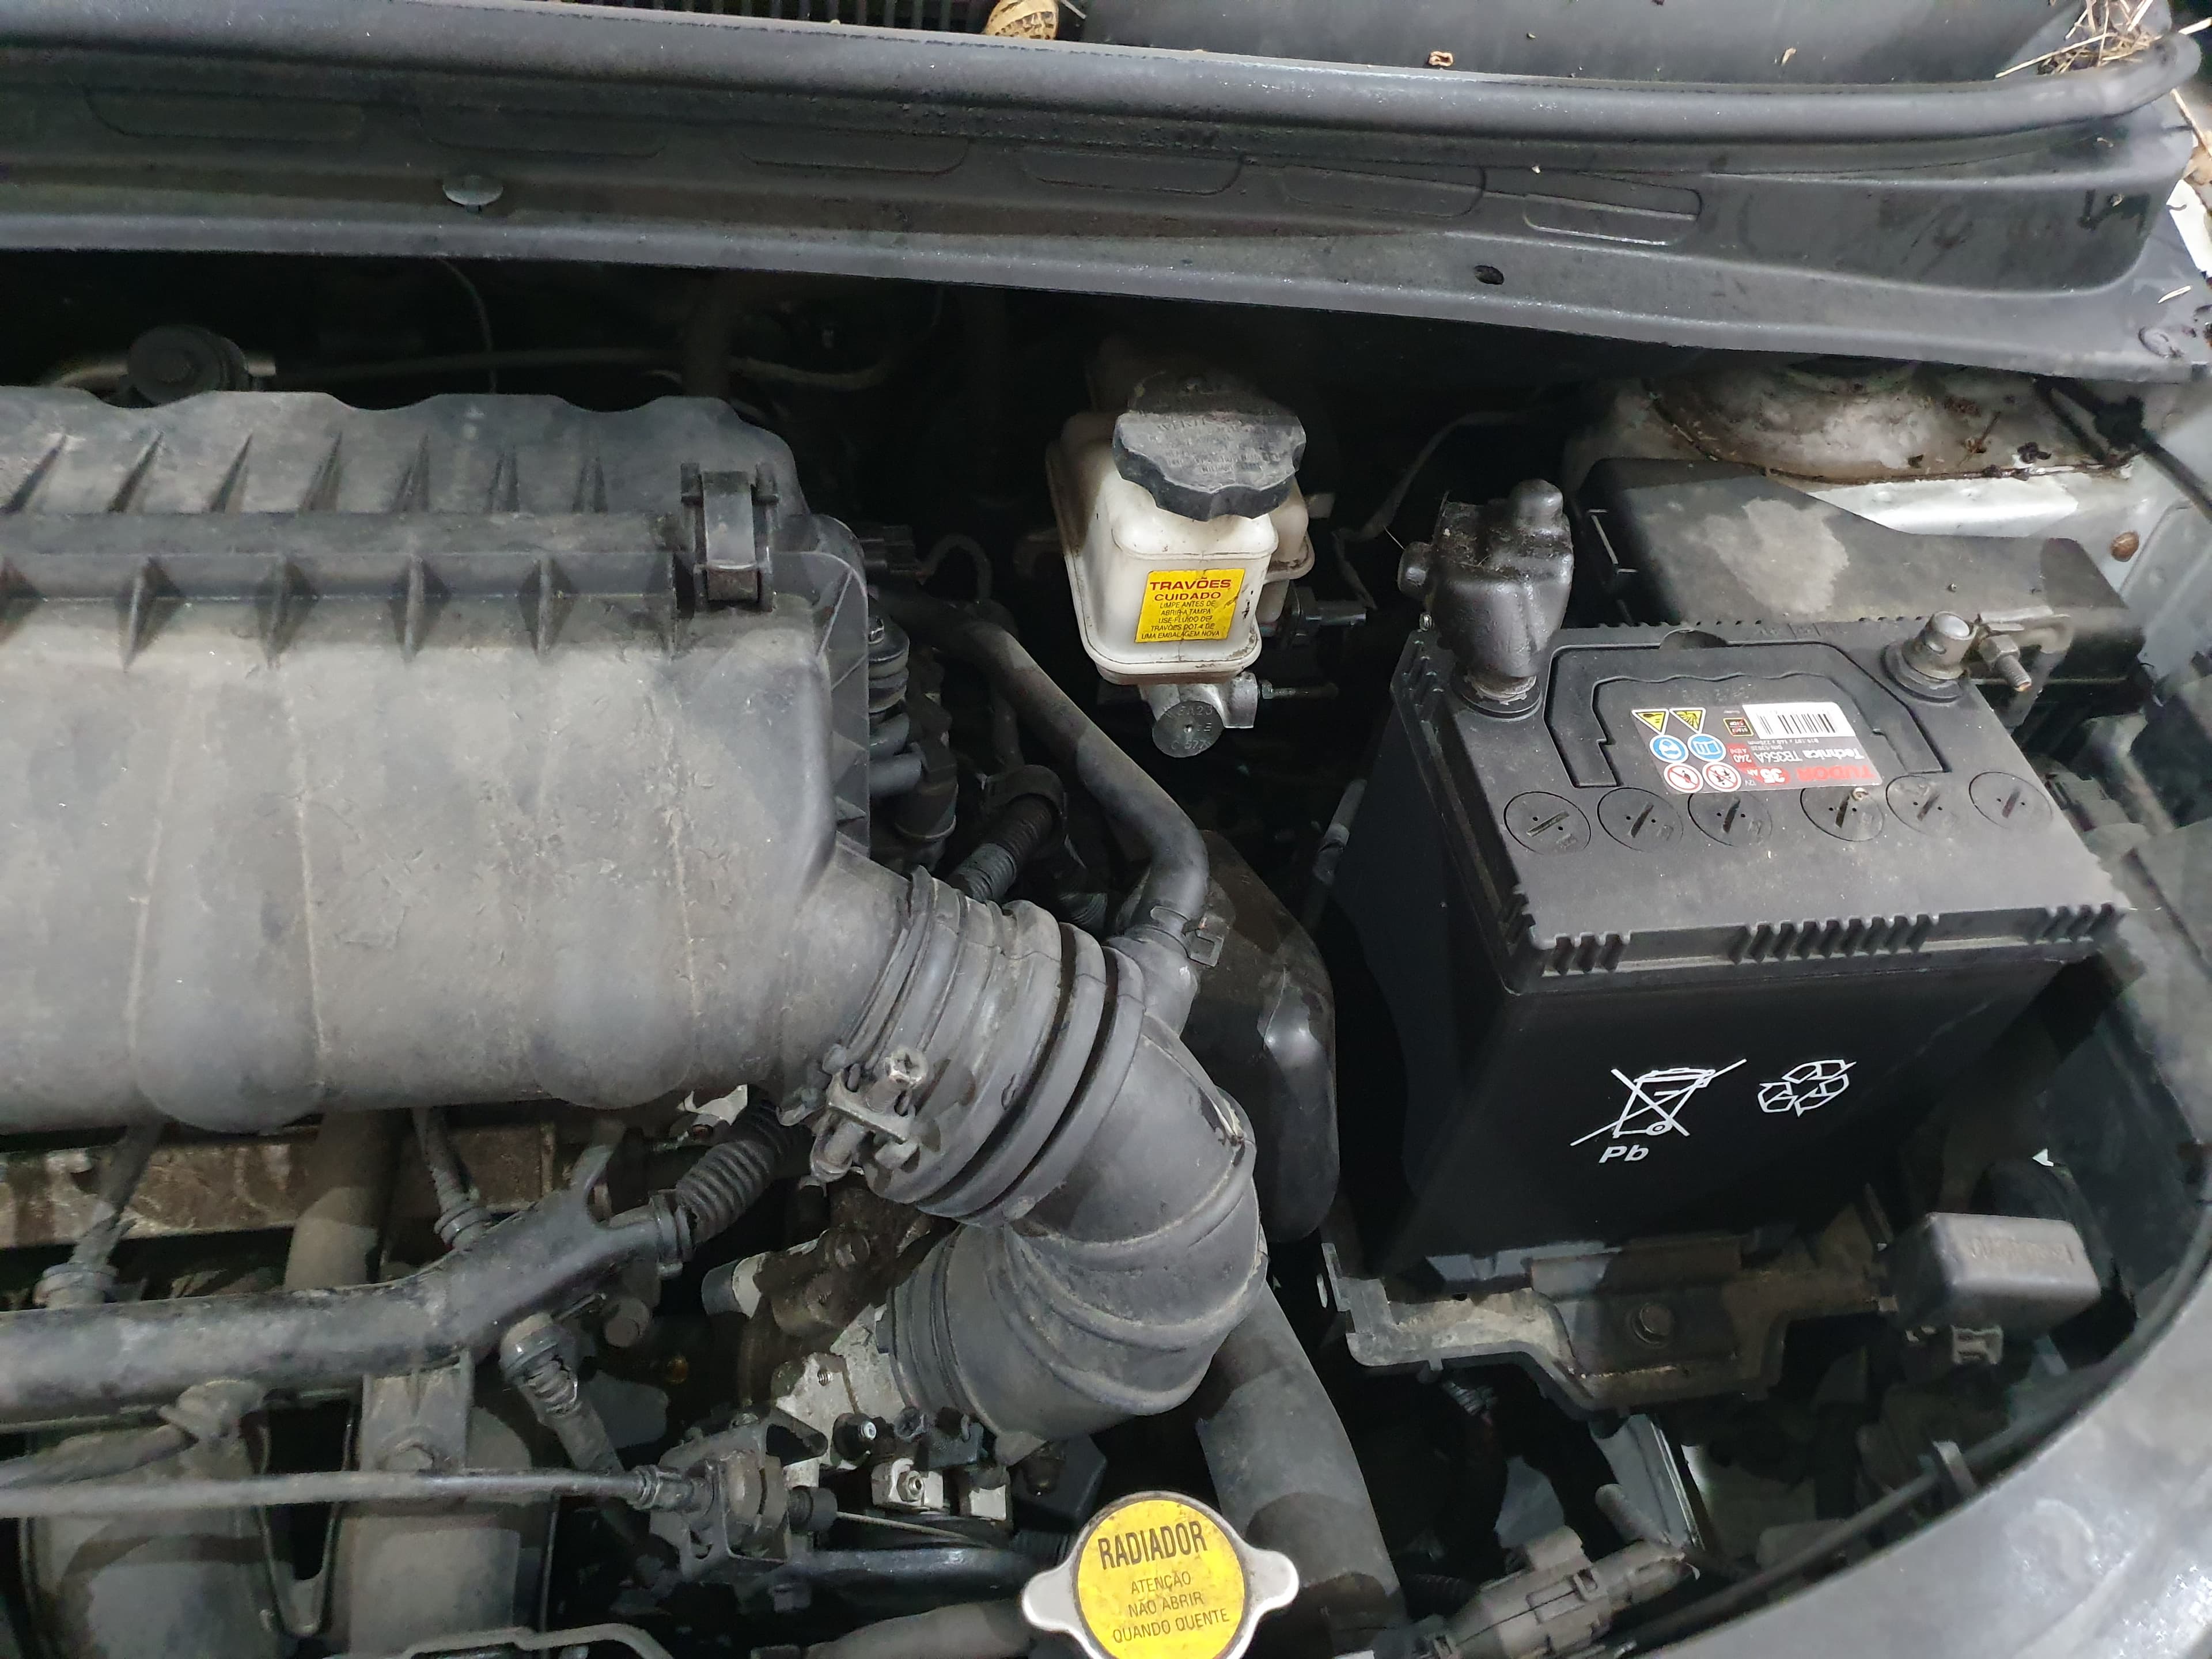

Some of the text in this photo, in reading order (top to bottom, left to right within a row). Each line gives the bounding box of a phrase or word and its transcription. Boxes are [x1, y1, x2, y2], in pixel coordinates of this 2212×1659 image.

[1150, 577, 1232, 590] TRAVÕES
[1154, 592, 1221, 601] CUIDADO
[1158, 631, 1200, 639] EMBALAGEM
[1733, 754, 1752, 763] 240
[1753, 748, 1866, 763] Technica TB356A
[1760, 768, 1786, 783] 35
[1796, 764, 1876, 782] TUDOR
[1599, 1144, 1649, 1163] Pb
[1097, 1520, 1208, 1570] RADIADOR
[1131, 1570, 1191, 1594] ATENÇÃO
[1128, 1590, 1205, 1618] NÃO ABRIR
[1113, 1608, 1230, 1643] QUANDO QUENTE
